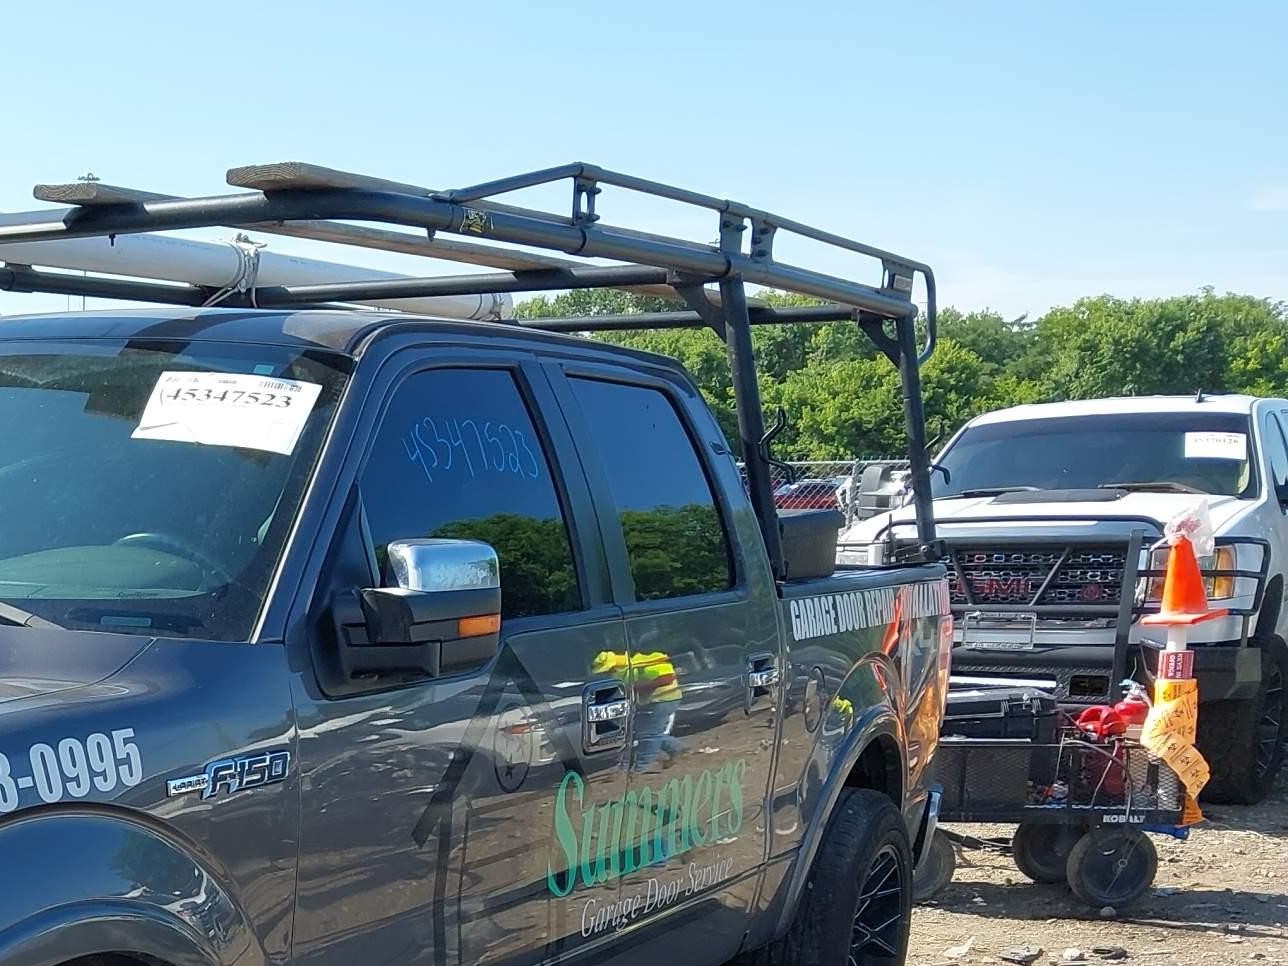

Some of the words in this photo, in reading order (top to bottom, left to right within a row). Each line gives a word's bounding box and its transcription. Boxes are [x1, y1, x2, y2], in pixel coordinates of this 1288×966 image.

[402, 417, 539, 483] 45347523
[790, 596, 838, 641] GARAGE
[836, 592, 867, 632] DOOR
[865, 588, 896, 627] REPAIR
[547, 758, 746, 897] Summers
[581, 893, 642, 938] Garage
[641, 877, 682, 914] Door
[685, 854, 734, 897] Service
